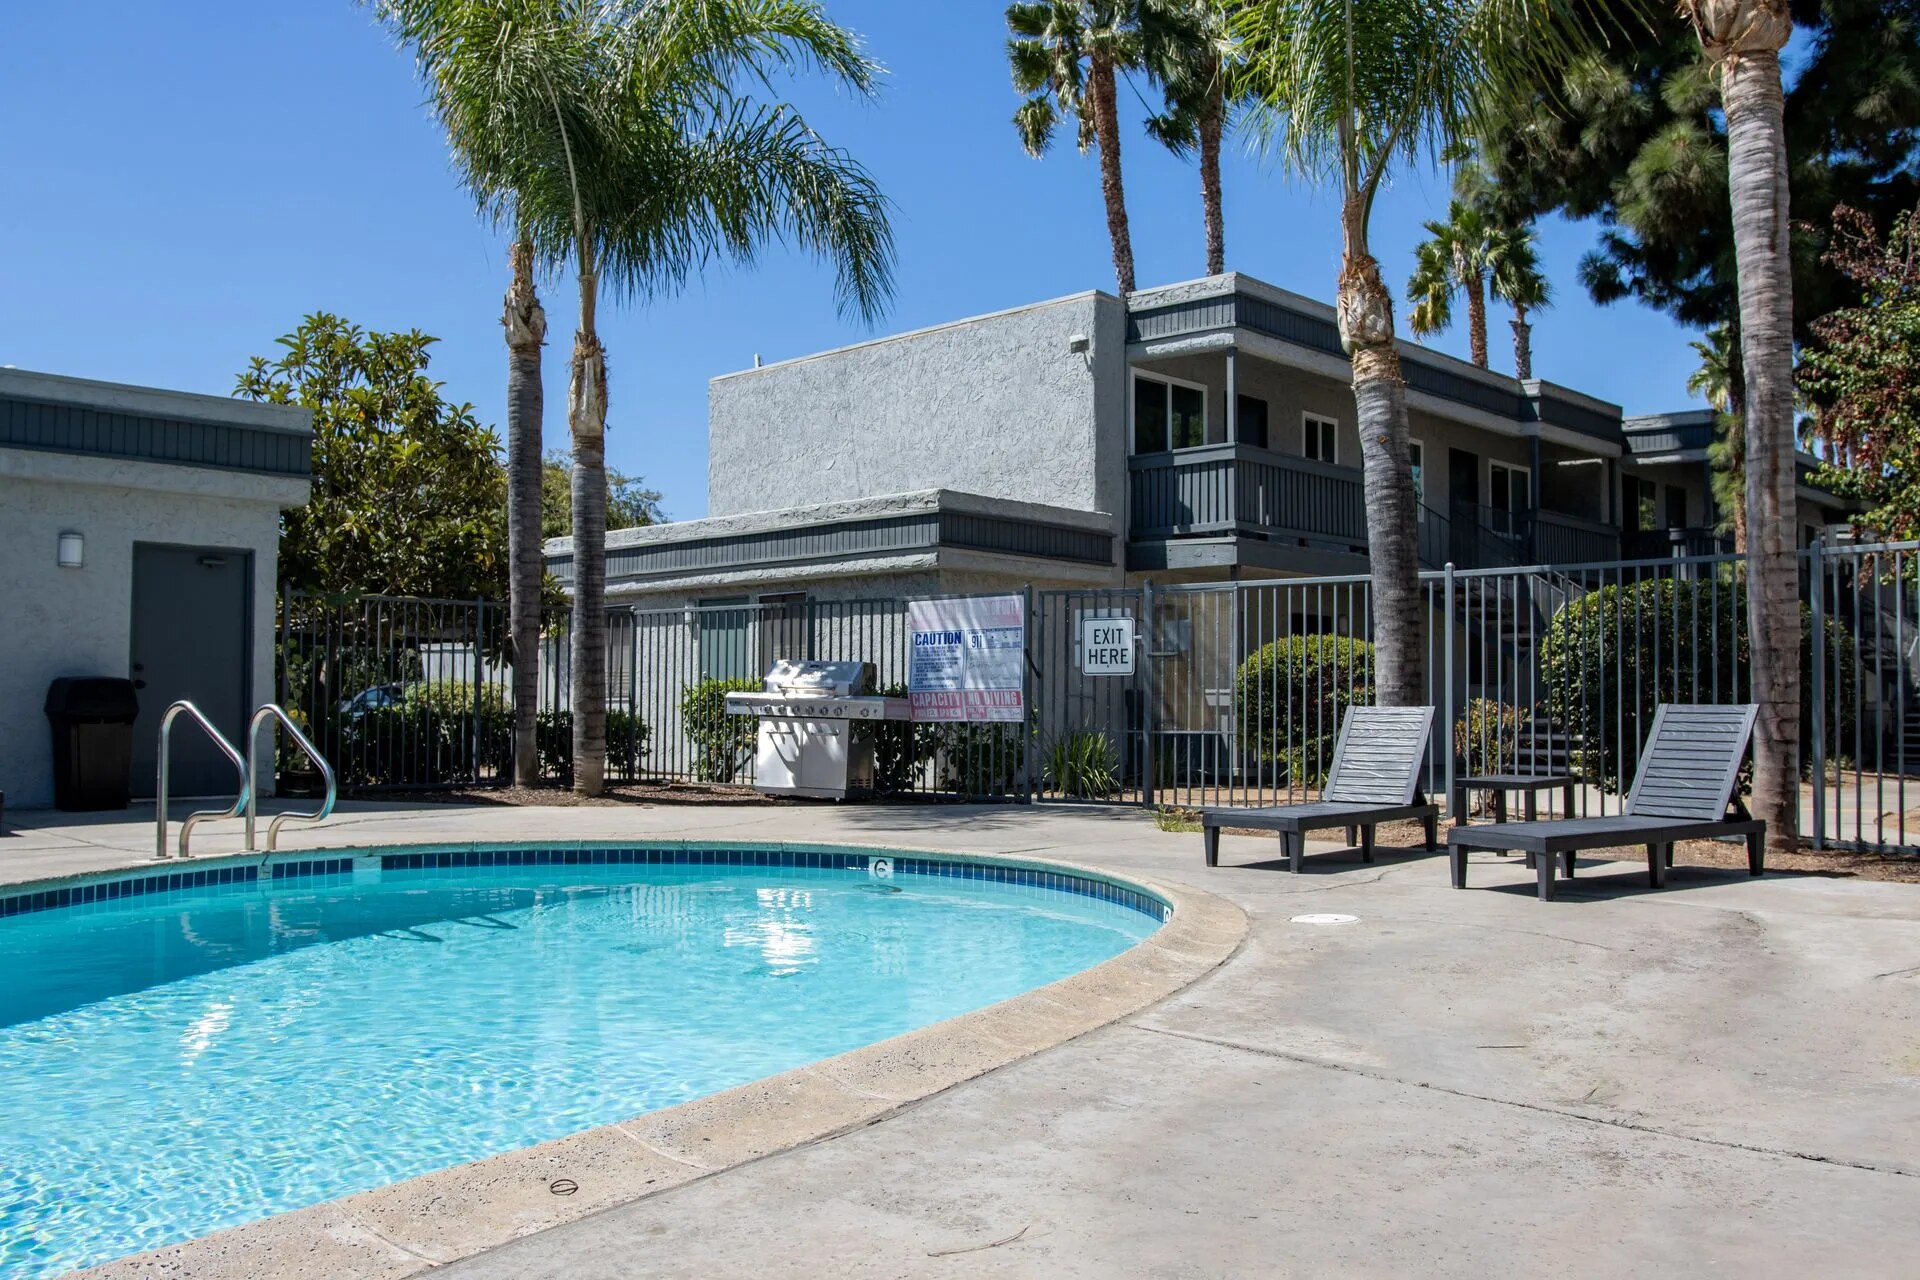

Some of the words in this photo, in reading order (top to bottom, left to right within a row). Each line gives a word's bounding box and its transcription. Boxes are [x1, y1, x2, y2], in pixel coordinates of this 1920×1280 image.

[915, 632, 961, 645] CAUTION
[972, 635, 982, 648] 911
[1094, 629, 1123, 644] EXIT
[1089, 648, 1128, 664] HERE
[912, 692, 960, 706] CAPACITY
[967, 692, 979, 705] NO
[984, 691, 1017, 705] DIVING
